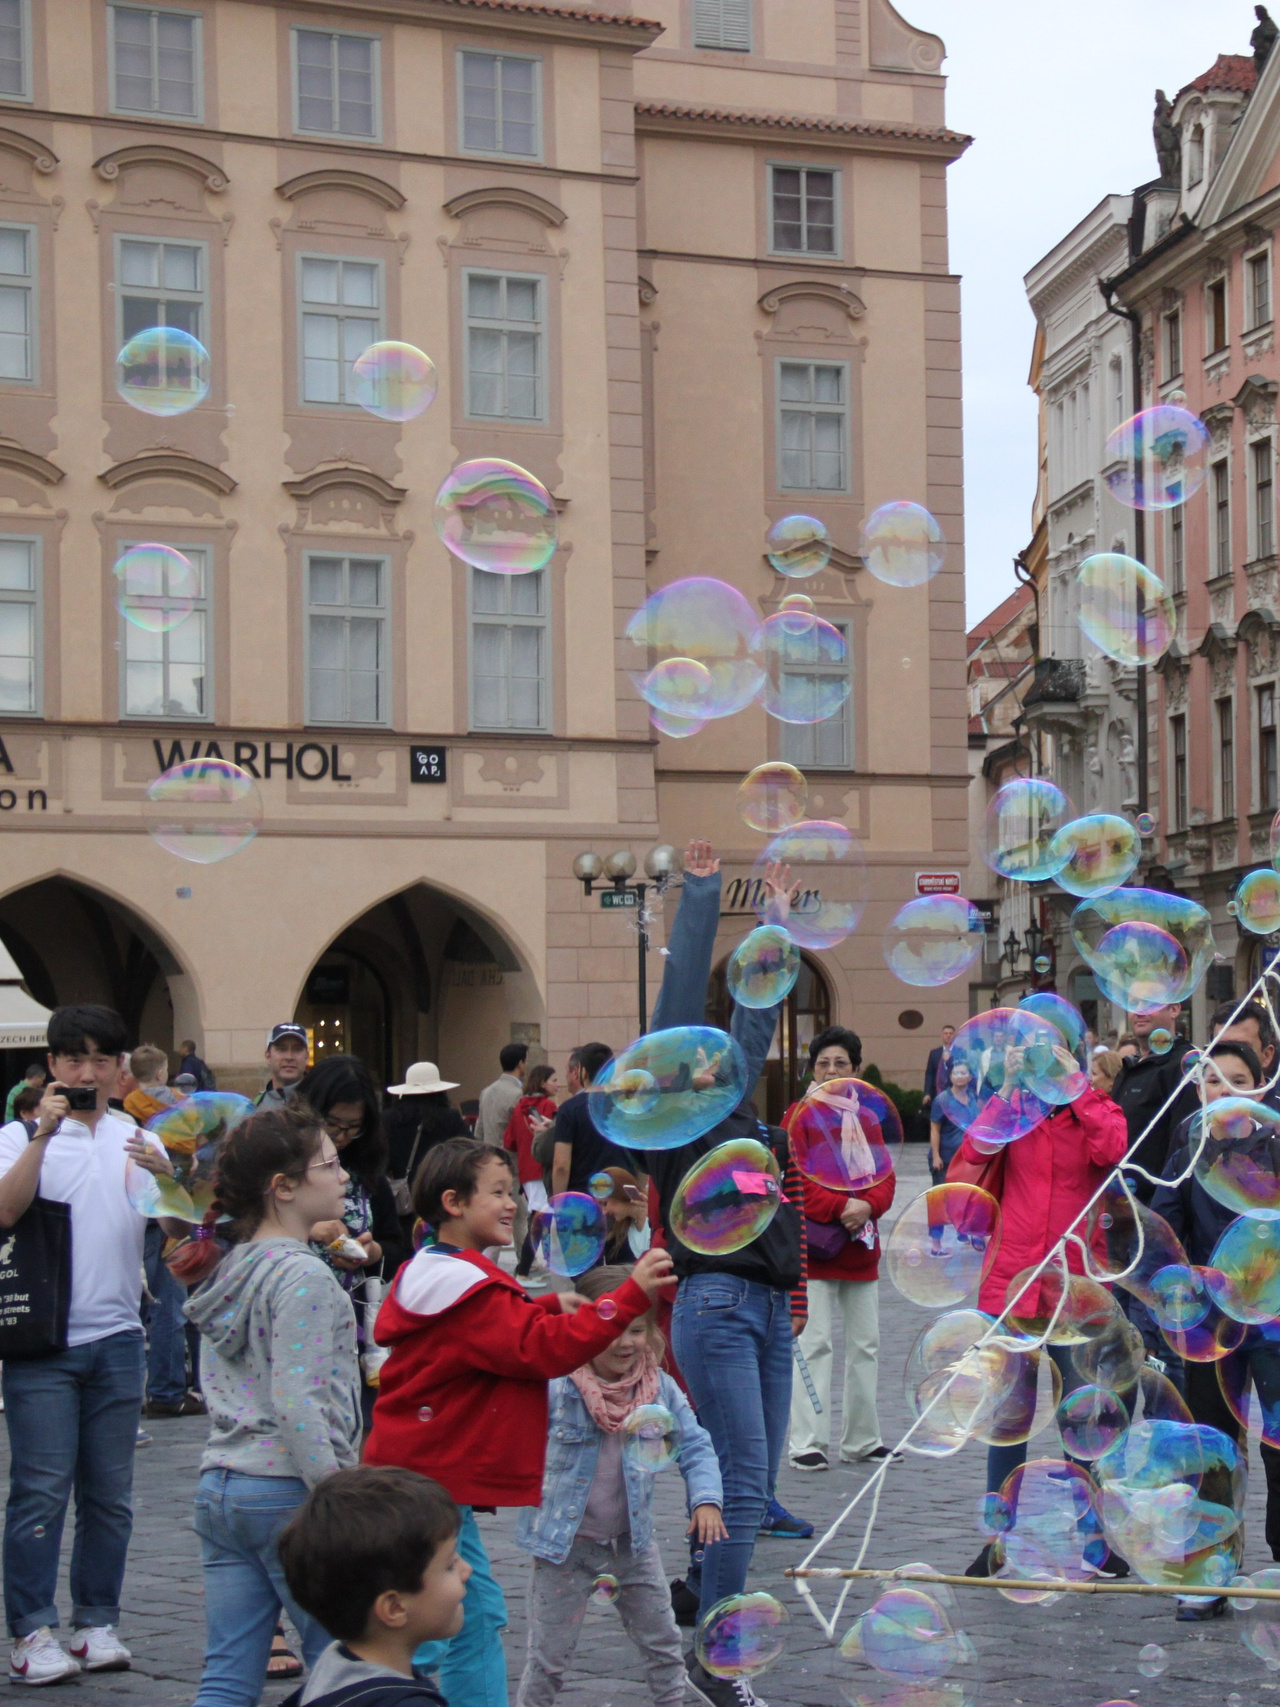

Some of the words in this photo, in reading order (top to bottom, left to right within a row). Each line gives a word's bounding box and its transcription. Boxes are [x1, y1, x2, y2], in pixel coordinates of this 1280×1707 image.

[153, 740, 352, 780] WARHOL
[612, 895, 624, 905] WC
[14, 1293, 30, 1301] but
